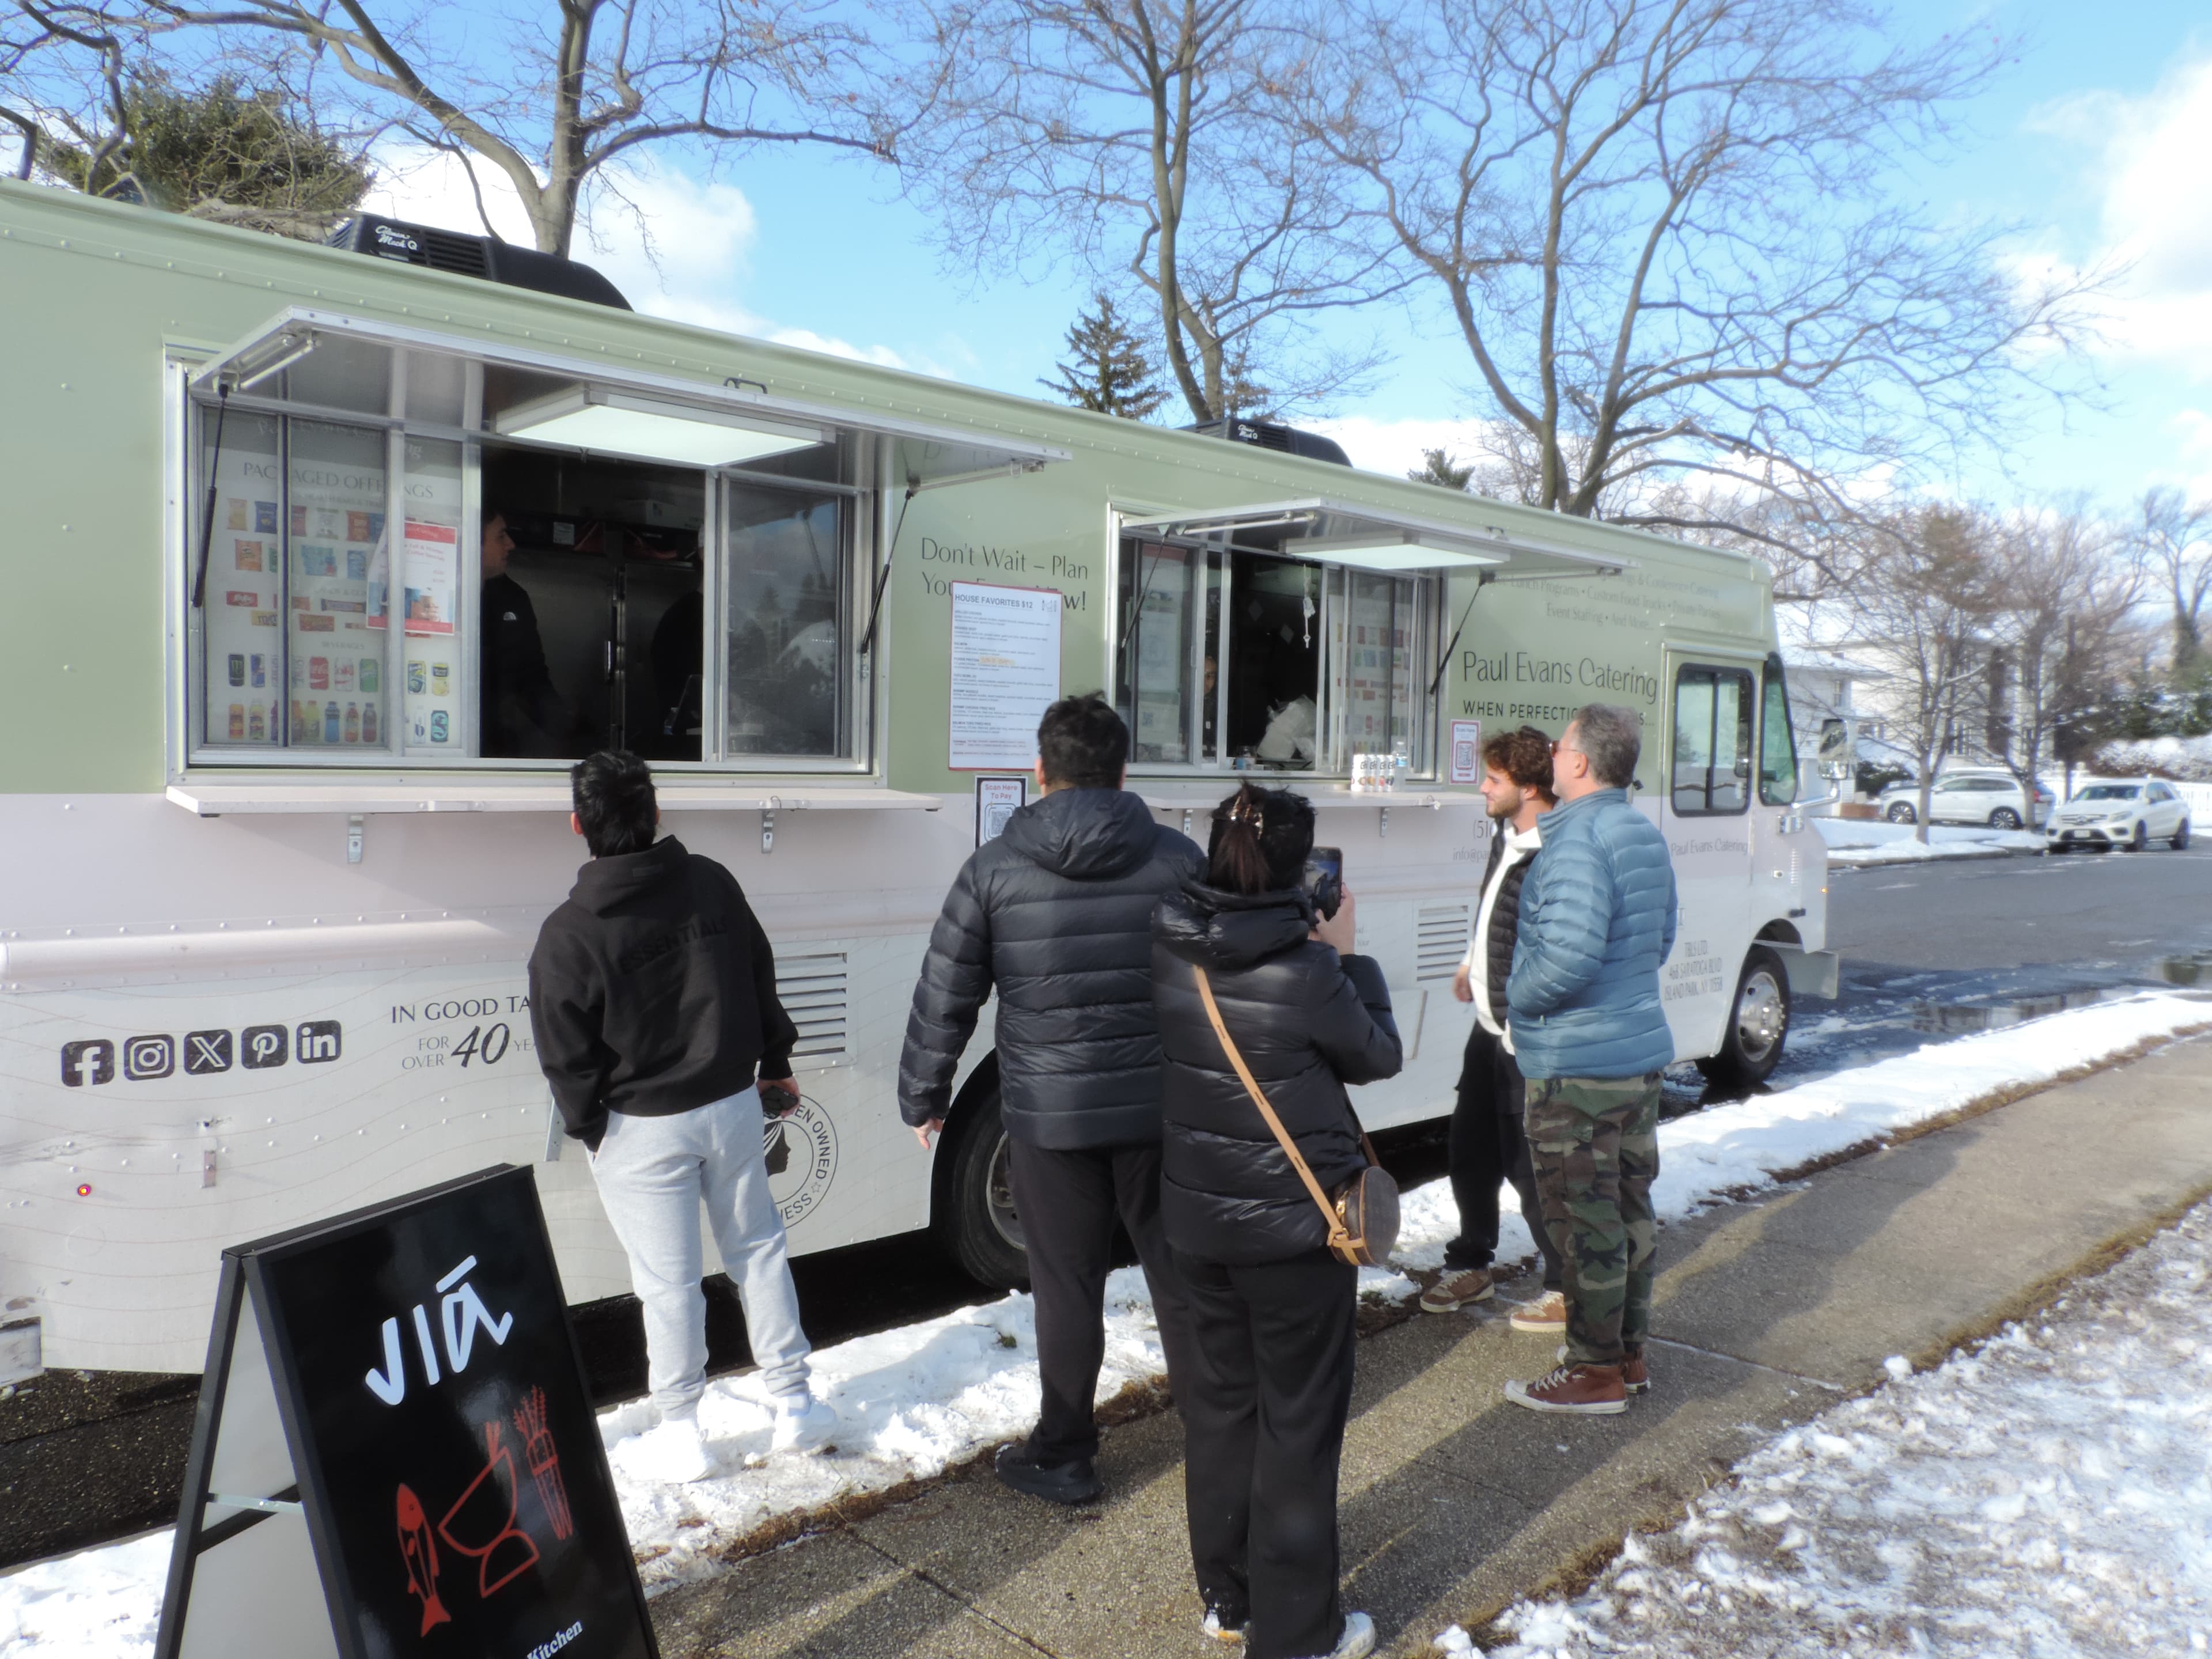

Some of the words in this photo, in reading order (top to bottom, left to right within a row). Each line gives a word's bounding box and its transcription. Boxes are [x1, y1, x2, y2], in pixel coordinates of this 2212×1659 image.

[244, 461, 339, 487] PACAGED
[344, 475, 433, 499] OFFENGS
[922, 537, 975, 565] Don't
[983, 546, 1025, 572] Wait
[1052, 555, 1088, 579] Plan
[955, 594, 979, 603] HOUSE
[981, 597, 1020, 607] FAVORITES
[1022, 601, 1033, 609] $12
[1463, 651, 1508, 682] Paul
[1516, 652, 1572, 684] Evans
[1579, 658, 1657, 704] Catering
[1463, 700, 1503, 717] WHEN
[1510, 703, 1579, 721] PERFECTI
[1671, 842, 1688, 856] Paul
[1690, 839, 1713, 853] Evans
[1714, 838, 1748, 856] Catering
[392, 1005, 415, 1023] IN
[425, 998, 498, 1020] GOOD
[419, 1036, 449, 1051] FOR
[451, 1022, 510, 1068] 40
[402, 1054, 444, 1070] OVER
[813, 1120, 831, 1180] OWNED
